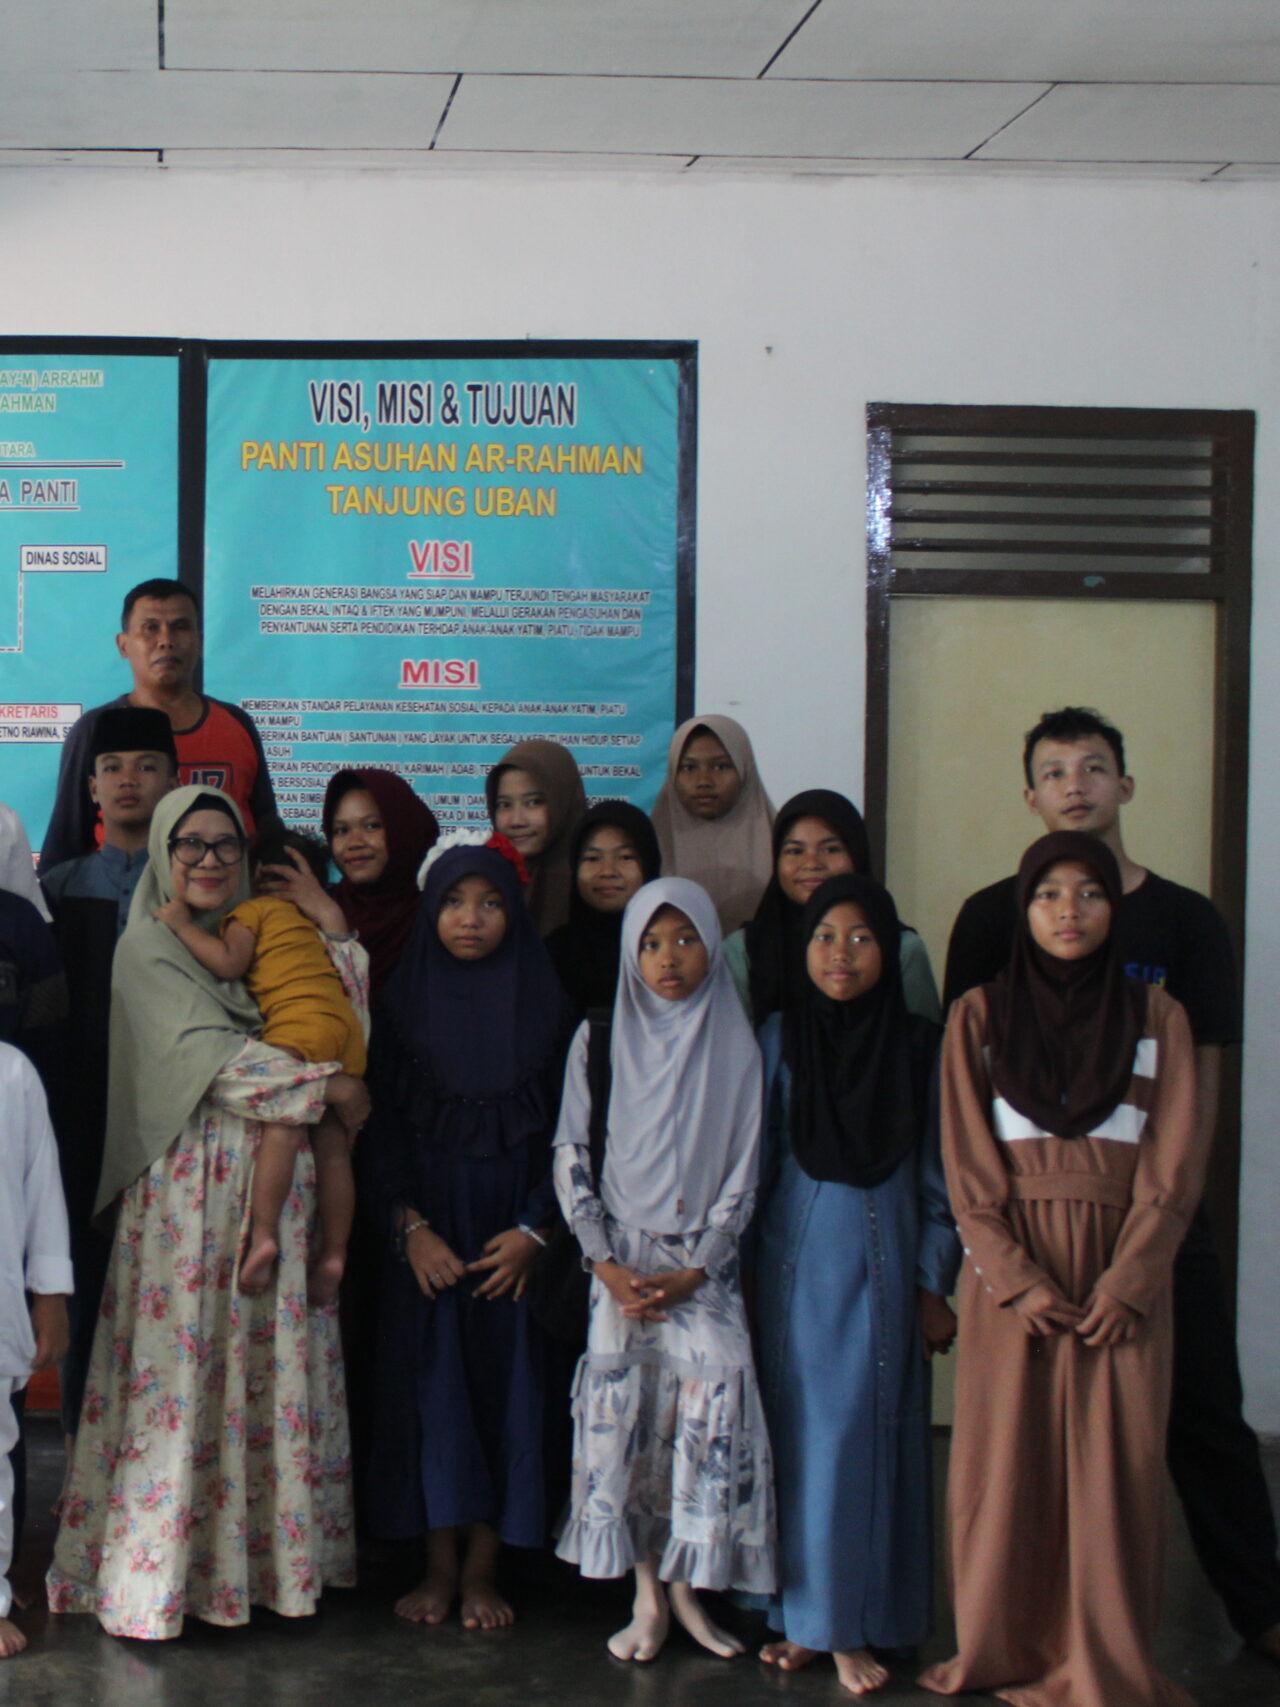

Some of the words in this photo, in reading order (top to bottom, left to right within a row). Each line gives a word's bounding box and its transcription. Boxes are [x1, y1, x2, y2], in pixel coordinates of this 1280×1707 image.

[310, 382, 370, 431] VISI,
[378, 382, 432, 424] MISI
[441, 383, 460, 425] &
[467, 383, 576, 426] TUJUAN
[241, 441, 325, 470] PANTI
[333, 442, 457, 472] ASUHAN
[465, 443, 643, 475] AR-RAHMAN
[21, 481, 77, 503] PANTI
[327, 485, 466, 516] TANJUNG
[475, 488, 557, 517] UBAN
[26, 551, 59, 565] DINAS
[63, 552, 102, 565] SOSIAL
[410, 541, 471, 573] VISI
[252, 587, 310, 599] MELAHIRKAN
[313, 588, 358, 599] GENERASI
[361, 588, 397, 599] BANGSA
[400, 588, 423, 600] YANG
[427, 588, 446, 600] SIAP
[448, 589, 468, 600] DAN
[470, 590, 502, 601] MAMPU
[552, 591, 588, 601] TENGAH
[590, 591, 651, 602] MASYARAKAT
[260, 604, 298, 615] DENGAN
[300, 604, 329, 616] BEKAL
[398, 605, 421, 616] YANG
[471, 606, 509, 618] MELALUI
[513, 607, 556, 618] GERAKAN
[559, 608, 620, 619] PENGASUHAN
[622, 608, 641, 619] DAN
[261, 621, 328, 633] PENYANTUNAN
[330, 622, 358, 633] SERTA
[361, 622, 415, 634] PENDIDIKAN
[463, 624, 515, 635] ANAK-ANAK
[579, 625, 604, 636] TIDAK
[607, 625, 640, 637] MAMPU
[402, 661, 478, 684] MISI
[241, 700, 299, 711] MEMBERIKAN
[301, 701, 341, 711] STANDAR
[344, 701, 394, 712] PELAYANAN
[396, 702, 446, 712] KESEHATAN
[449, 703, 480, 713] SOSIAL
[482, 703, 515, 713] KEPADA
[518, 703, 568, 714] ANAK-ANAK
[269, 716, 300, 726] MAMPU
[301, 732, 342, 742] BANTUAN
[404, 733, 427, 743] YANG
[429, 733, 457, 743] LAYAK
[458, 733, 487, 744] UNTUK
[582, 735, 609, 745] HIDUP
[611, 735, 641, 746] SETIAP
[267, 746, 290, 757] ASUH
[404, 764, 445, 774] KARIMAH
[580, 765, 609, 776] UNTUK
[612, 766, 641, 777] BEKAL
[282, 808, 320, 818] SEBAGAI
